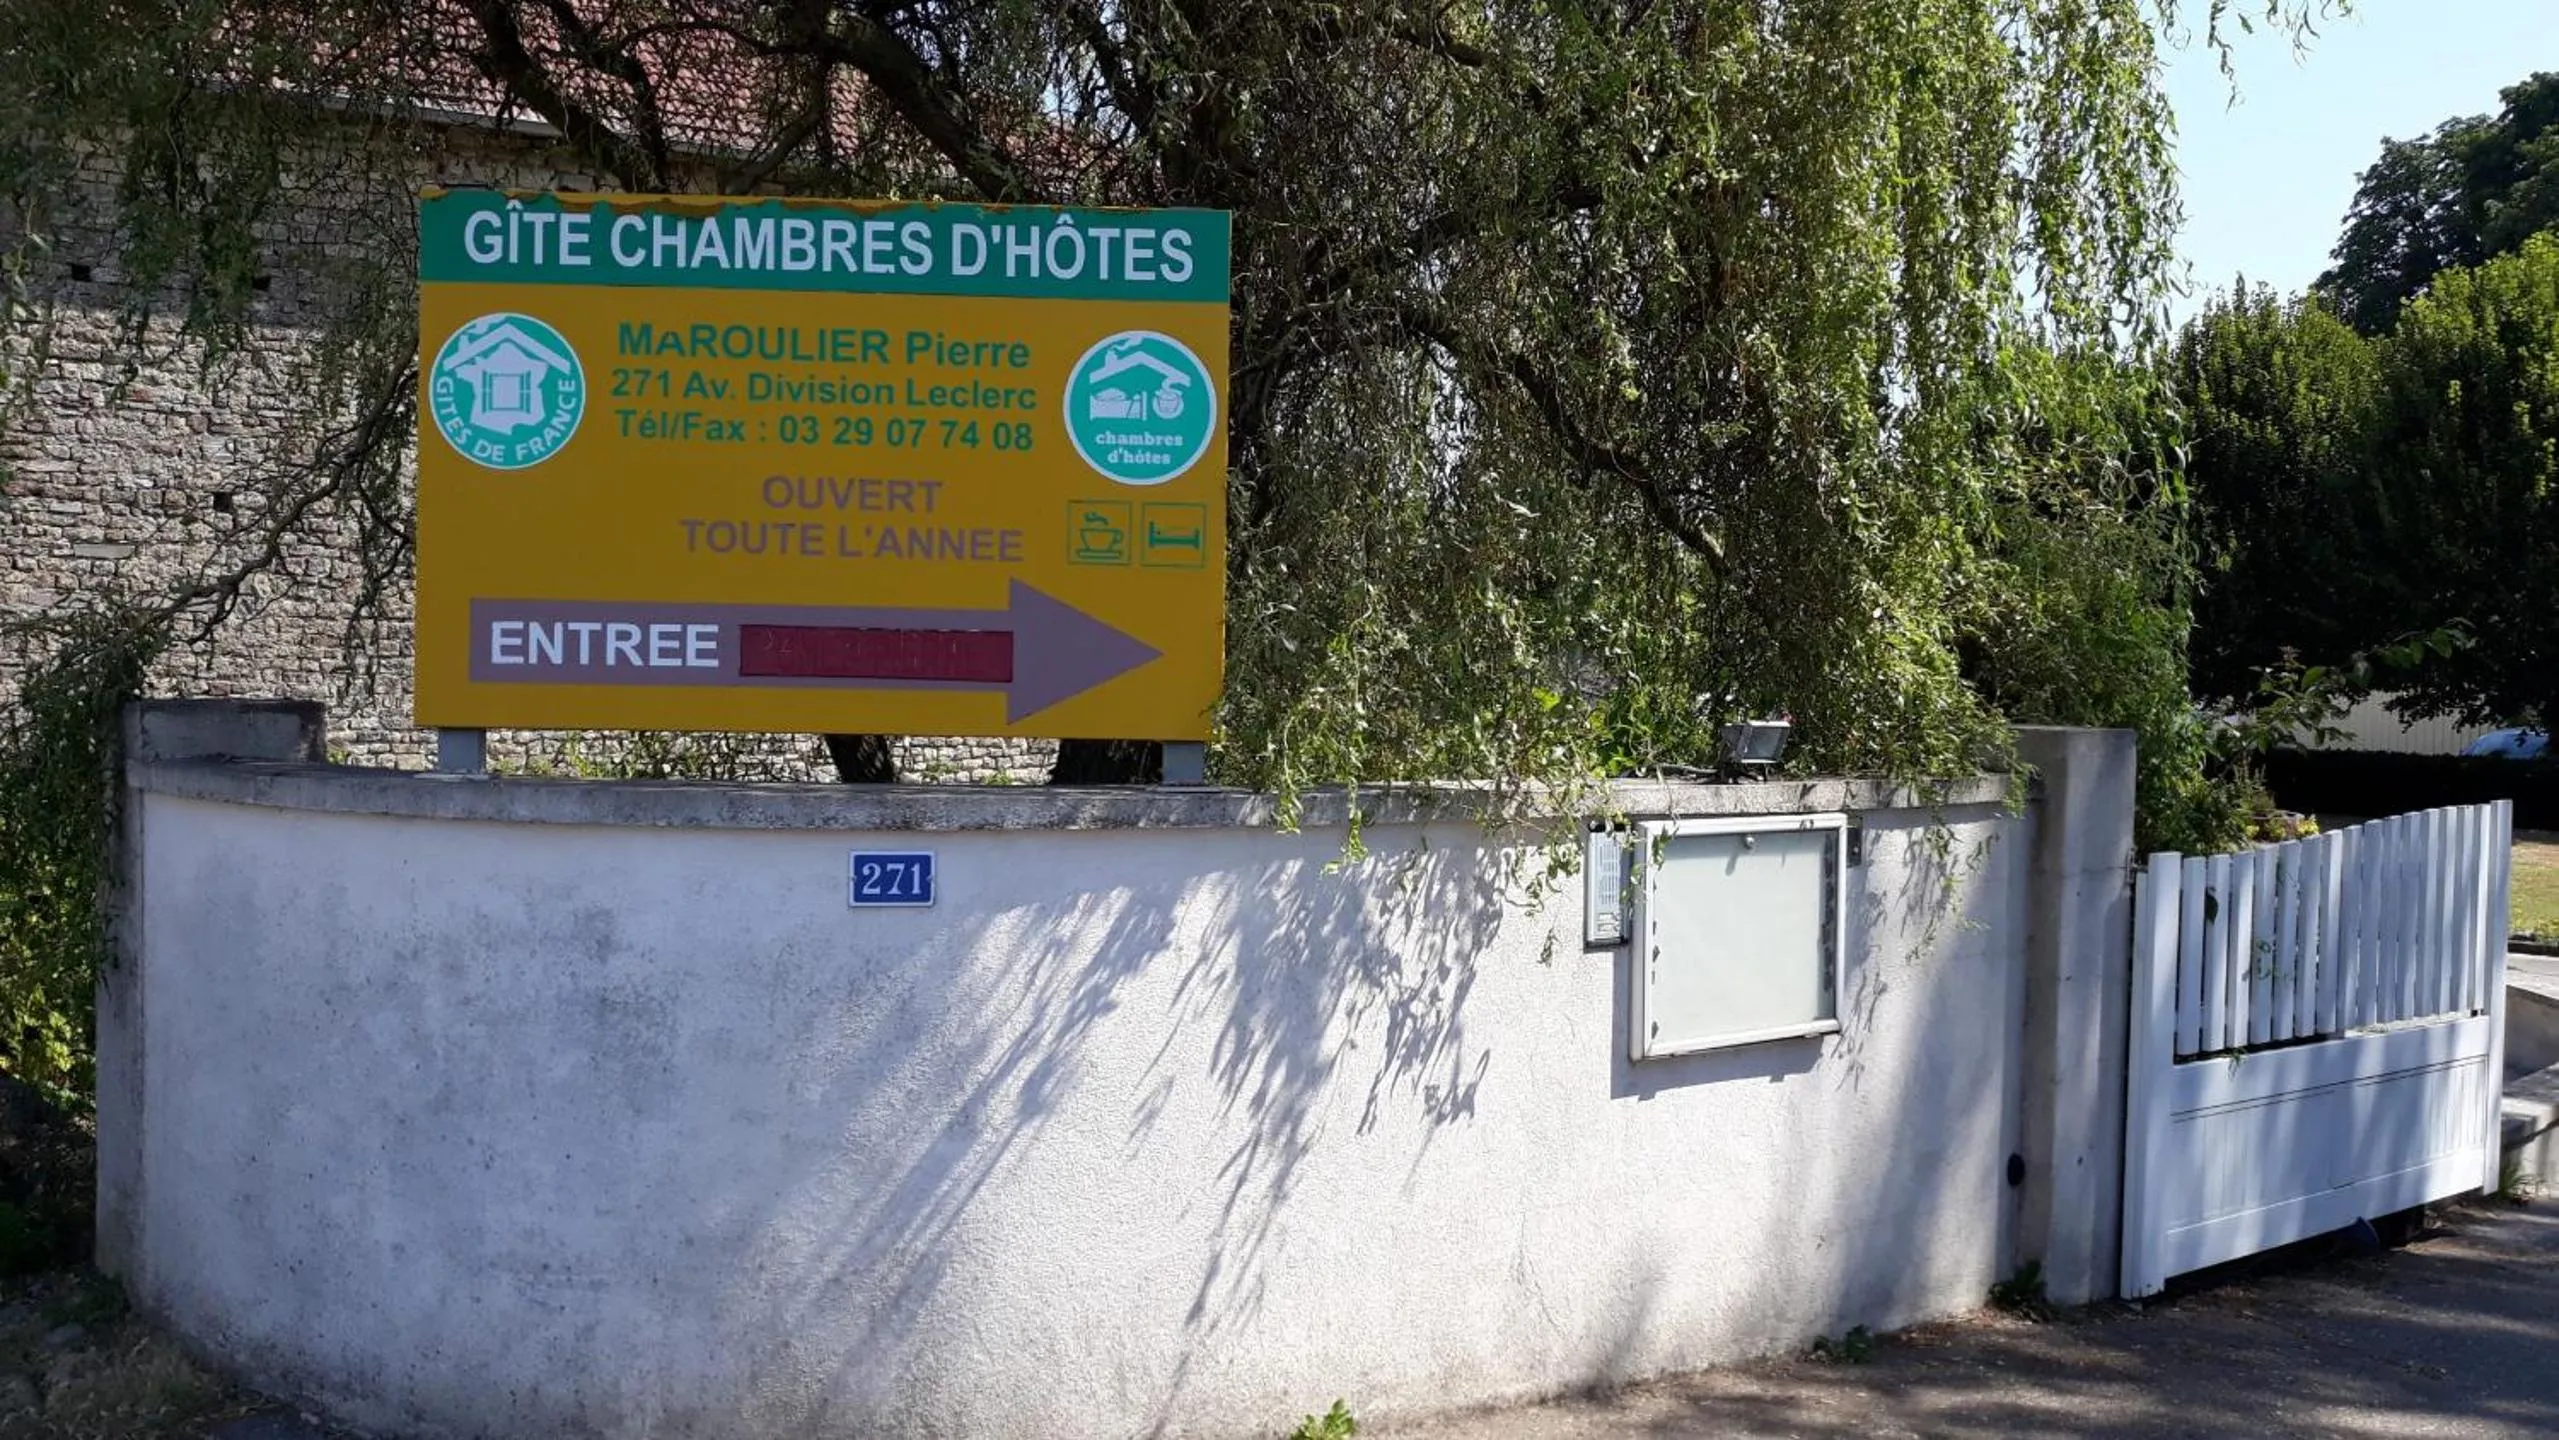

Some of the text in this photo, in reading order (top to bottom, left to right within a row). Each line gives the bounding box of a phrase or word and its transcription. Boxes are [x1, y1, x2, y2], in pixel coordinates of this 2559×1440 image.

[464, 199, 1194, 283] GÎTE CHAMBRES D'HÔTES
[906, 331, 1030, 368] Pierre
[612, 369, 669, 398] 271
[749, 373, 895, 405] Division
[906, 378, 1037, 410] Leclerc
[473, 439, 506, 462] DE
[515, 379, 577, 461] FRANCE
[615, 409, 745, 442] Tél/Fax
[779, 415, 820, 445] 03
[832, 416, 874, 446] 29
[886, 417, 928, 448] 07
[939, 420, 980, 450] 74
[992, 423, 1034, 451] 08
[1095, 431, 1184, 446] chambres
[762, 475, 943, 513] OUVERT
[680, 519, 1024, 562] TOUTE L'ANNEE
[491, 620, 720, 668] ENTREE
[862, 862, 922, 895] 271
